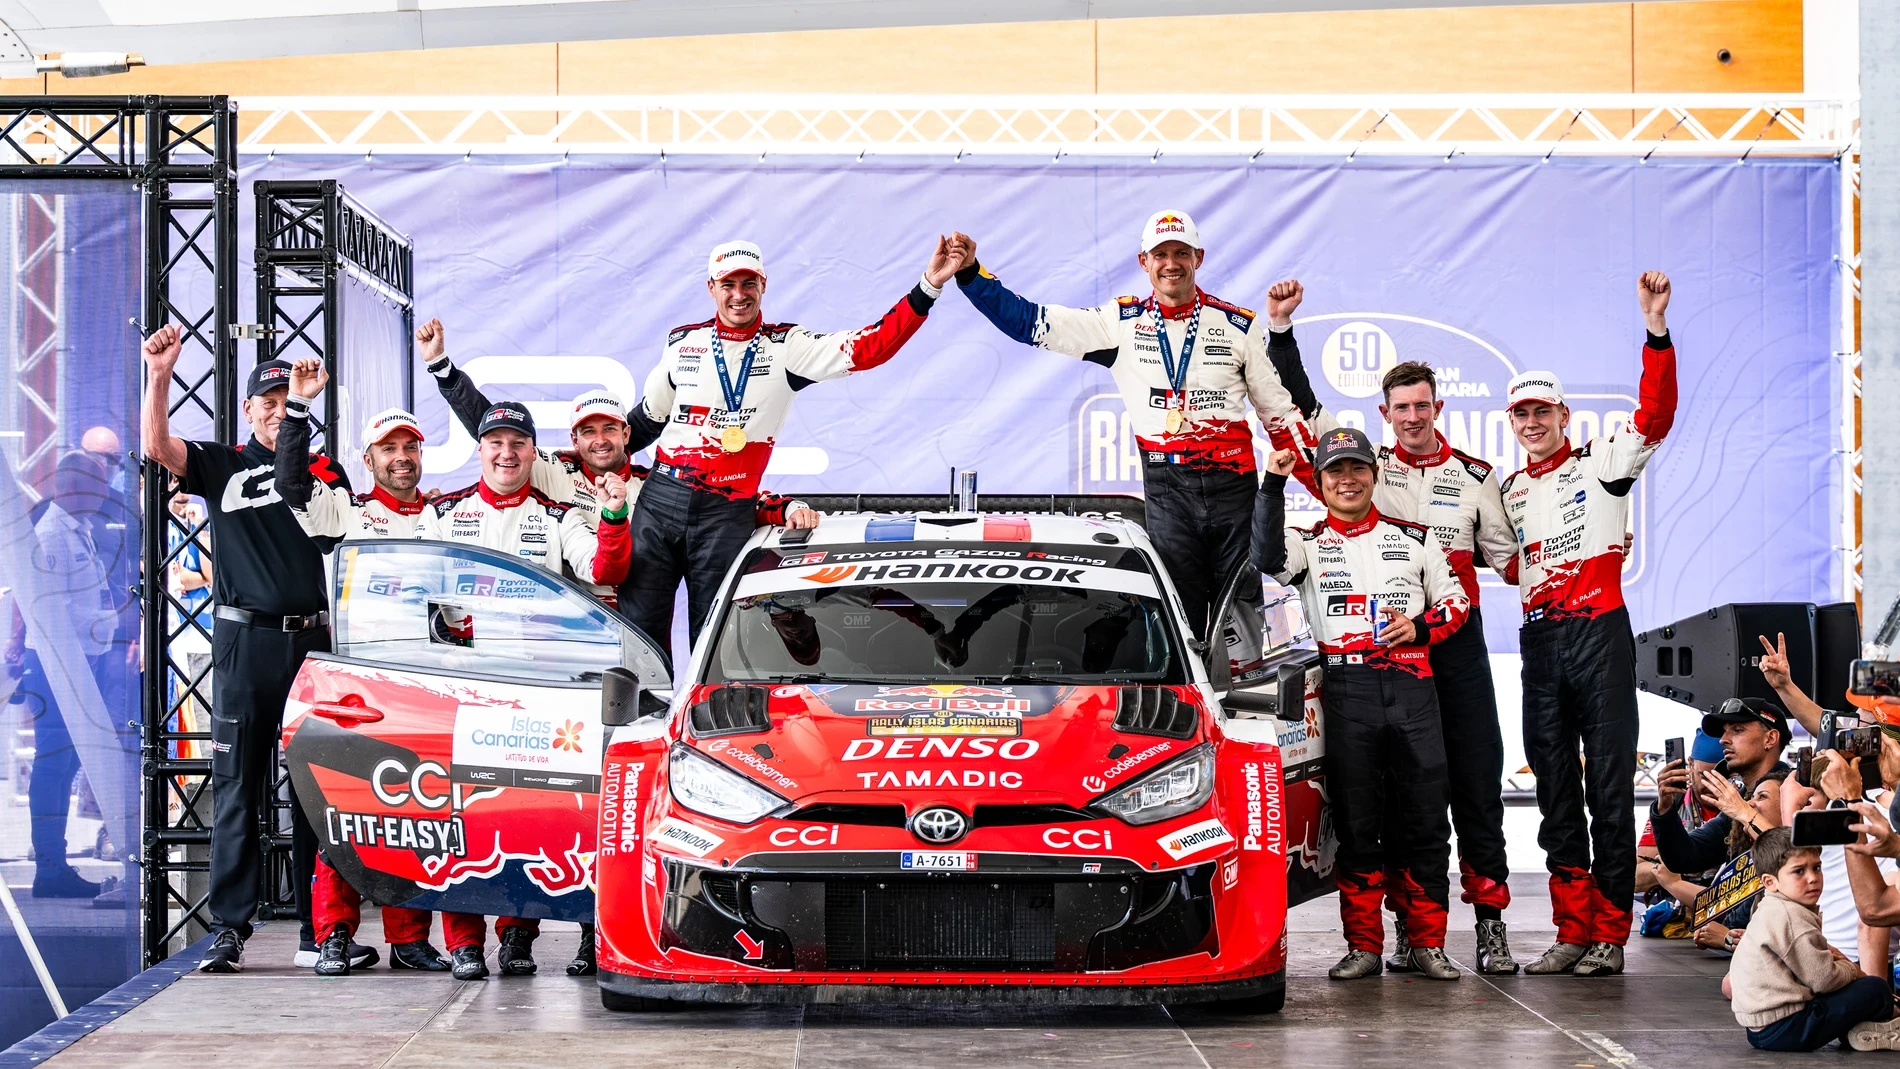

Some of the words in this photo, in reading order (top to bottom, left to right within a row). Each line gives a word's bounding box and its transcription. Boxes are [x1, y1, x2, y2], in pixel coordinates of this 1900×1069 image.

[1156, 225, 1170, 234] Red
[1171, 225, 1185, 233] Bull
[1134, 323, 1158, 332] DENS
[1339, 331, 1381, 372] 50
[1189, 396, 1226, 404] GAZOO
[1189, 402, 1225, 412] Racing
[673, 408, 708, 427] GR
[1227, 448, 1242, 457] OGIER
[1327, 442, 1342, 452] Red
[1342, 440, 1358, 448] Bull
[719, 473, 747, 482] LANDAIS
[1468, 464, 1488, 477] OMP
[1433, 477, 1466, 486] TAMADIC
[1508, 488, 1529, 500] DENSO
[1406, 528, 1424, 540] OMP
[1544, 524, 1585, 546] TOYOTA
[1544, 534, 1582, 553] GAZOO
[1544, 542, 1580, 560] Racing
[781, 553, 826, 567] GR
[832, 550, 928, 561] TOYOTA
[934, 548, 1022, 558] GAZOO
[1026, 551, 1107, 567] Racing
[456, 578, 493, 597] GR
[1320, 580, 1354, 589] MAEDA
[1580, 588, 1602, 602] PAJARI
[1030, 602, 1058, 614] OMP
[1327, 600, 1366, 616] GR
[843, 613, 871, 628] OMP
[1328, 656, 1342, 664] OMP
[855, 698, 942, 712] Red
[949, 698, 1030, 712] Bull
[511, 716, 552, 732] Islas
[872, 718, 905, 727] RALLY
[908, 718, 946, 726] ISLAS
[950, 718, 1018, 726] CANARIAS
[472, 729, 550, 750] Canarias
[1277, 727, 1306, 748] anarias
[841, 738, 1040, 762] DENSO
[726, 746, 798, 790] codebeamer
[1104, 742, 1171, 779] codebeamer
[470, 772, 496, 780] WRC
[856, 770, 1023, 789] TAMADIC
[601, 762, 622, 857] AUTOMOTIVE
[620, 762, 645, 853] Panasonic
[1240, 762, 1262, 851] Panasonic
[1263, 762, 1281, 855] AUTOMOTIVE
[916, 856, 961, 866] A-7651
[1084, 864, 1101, 874] GR
[1696, 886, 1718, 911] RALLY
[1718, 872, 1742, 898] ISLAS
